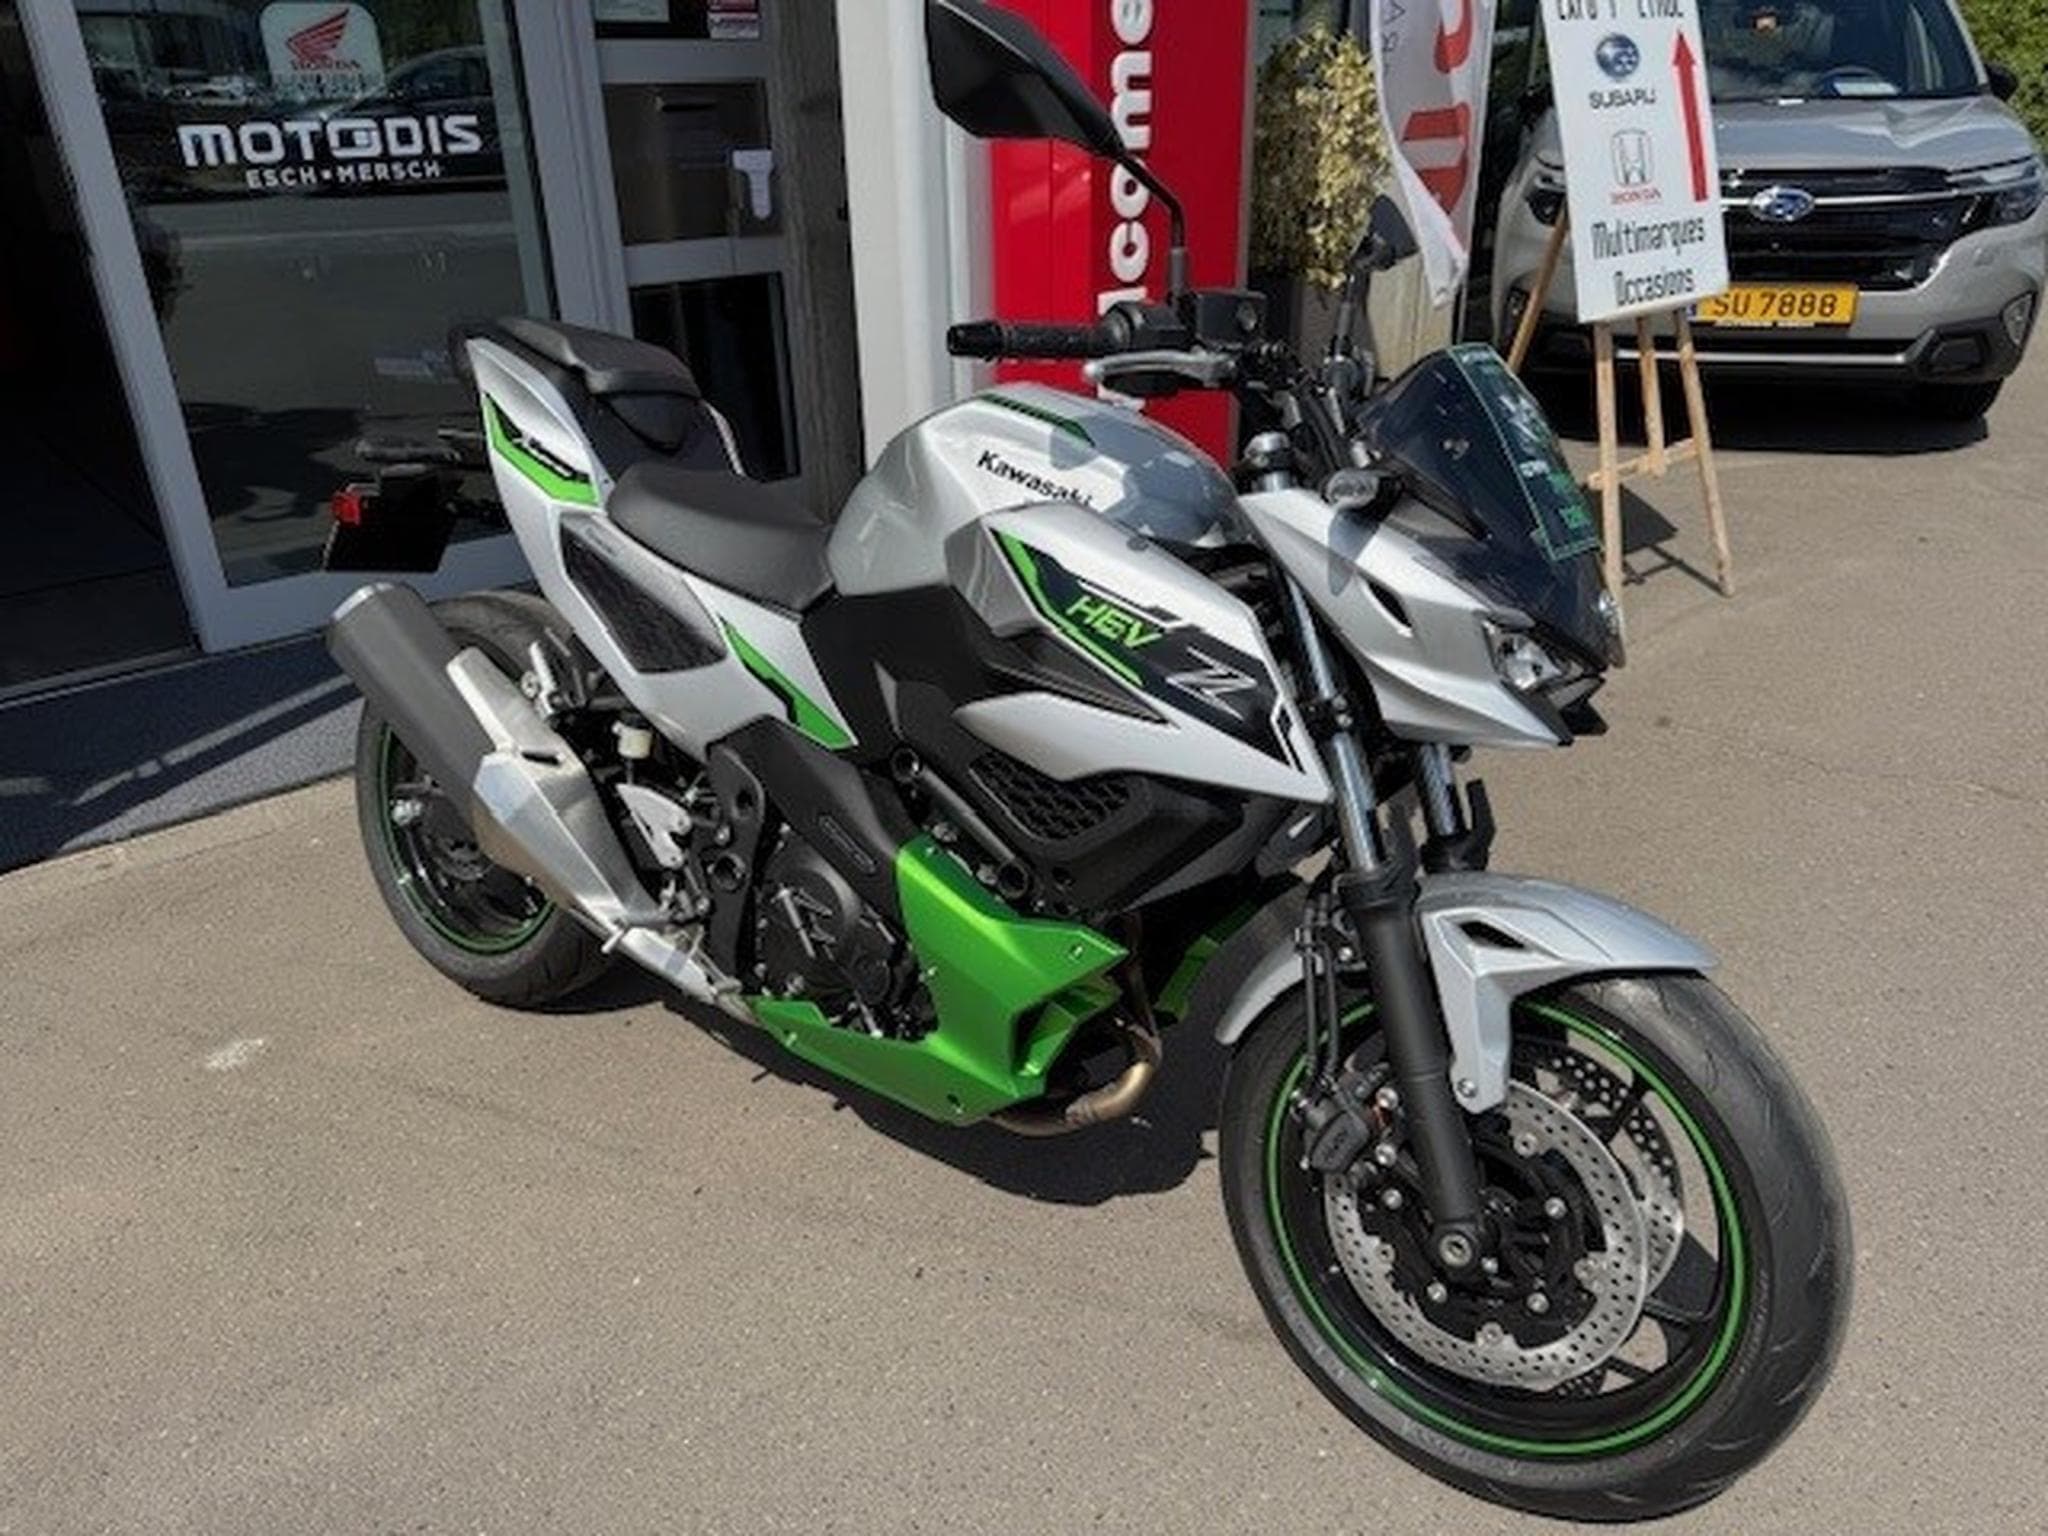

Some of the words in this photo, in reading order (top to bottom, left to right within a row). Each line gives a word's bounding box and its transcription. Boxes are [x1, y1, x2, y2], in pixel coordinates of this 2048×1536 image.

[1588, 88, 1657, 109] SUBARU
[246, 165, 317, 189] ESCH
[336, 160, 441, 183] MERSCH
[1591, 217, 1705, 260] Multimarques
[1614, 267, 1695, 307] Occasions
[1713, 292, 1751, 317] SU
[1760, 292, 1838, 317] 7888
[977, 450, 1092, 506] Kawasaki
[1066, 595, 1162, 648] HEV
